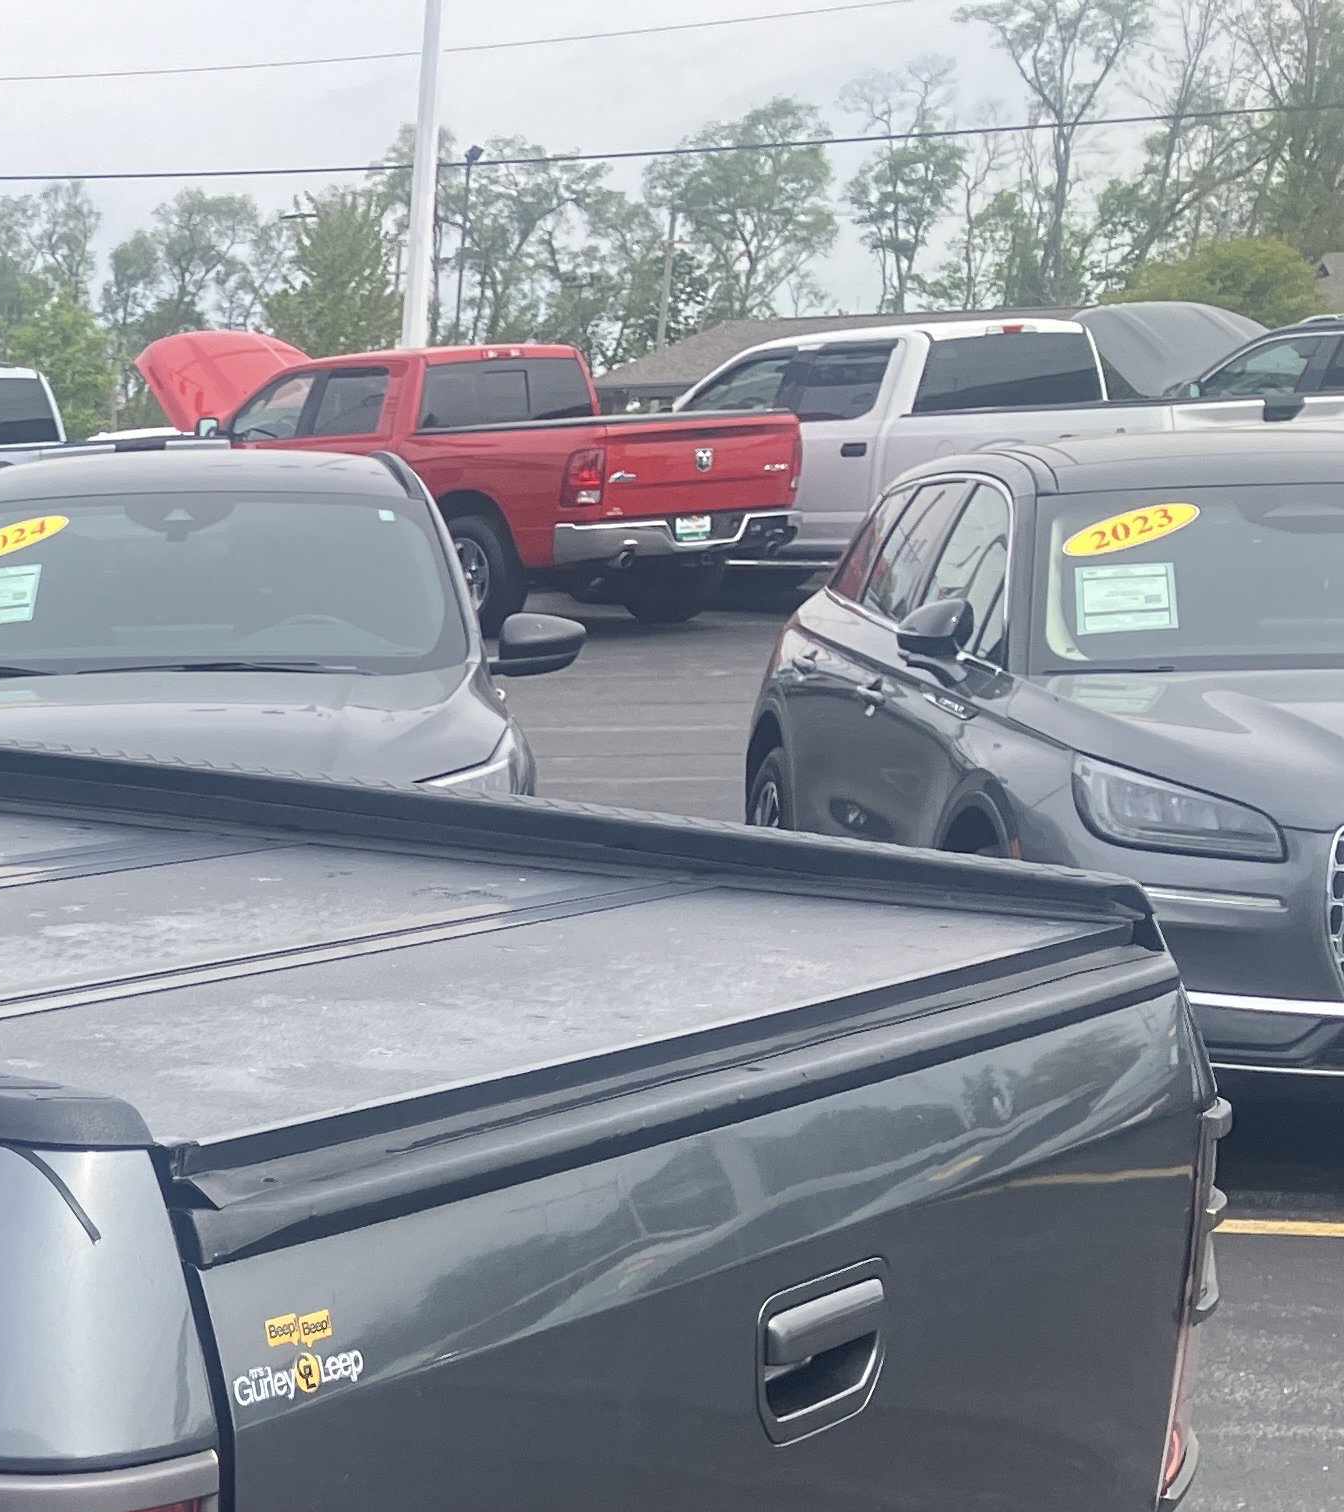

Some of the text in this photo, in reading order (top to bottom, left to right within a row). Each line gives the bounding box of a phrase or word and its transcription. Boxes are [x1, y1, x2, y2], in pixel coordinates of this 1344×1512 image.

[1090, 508, 1174, 550] 2023
[233, 1365, 296, 1406] Gurley
[318, 1349, 364, 1384] Leep
